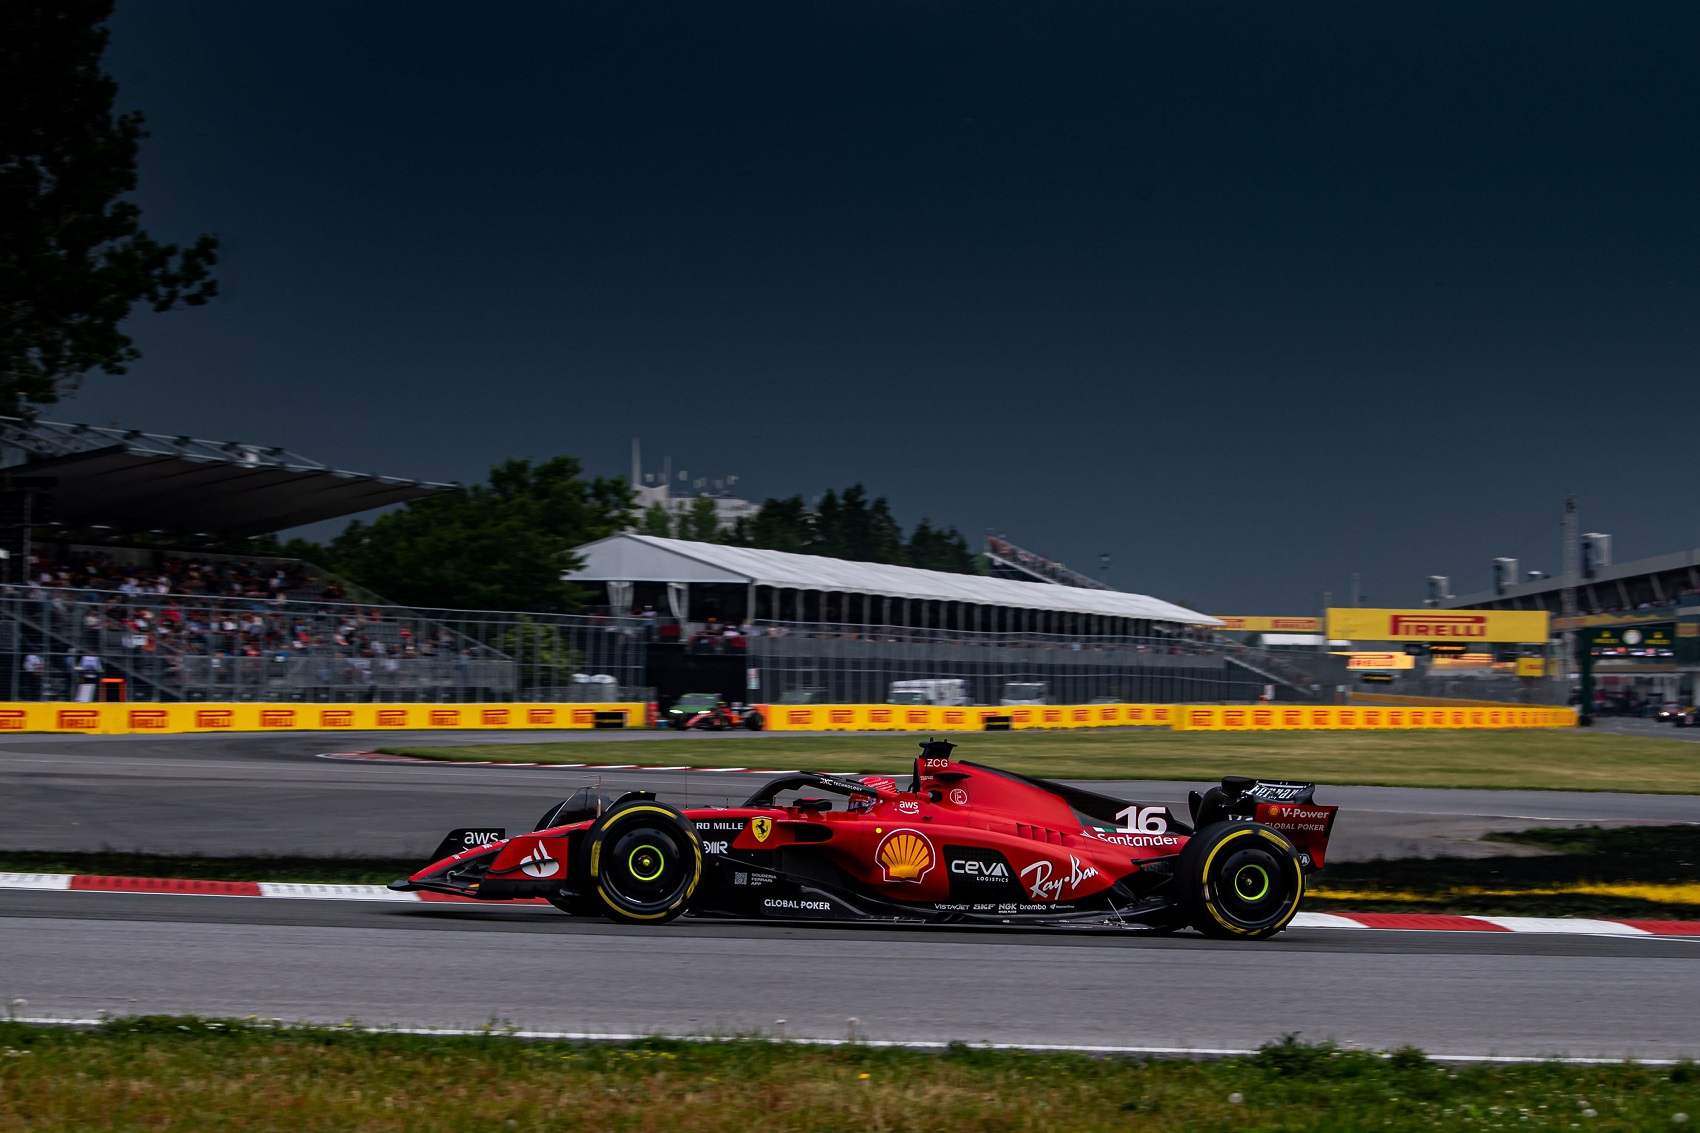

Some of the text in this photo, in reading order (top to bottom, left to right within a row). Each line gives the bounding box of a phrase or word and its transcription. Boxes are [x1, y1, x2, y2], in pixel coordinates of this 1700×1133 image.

[1390, 614, 1488, 637] PIRELLI
[57, 710, 99, 728] PIRELLI
[128, 710, 168, 728] PIRELLI
[195, 710, 234, 727] PIRELLI
[926, 758, 948, 768] ZCG
[833, 781, 863, 792] TECHNOLOGY
[899, 800, 919, 810] aws
[1115, 805, 1167, 835] 16
[1281, 807, 1329, 819] V-Power
[713, 822, 744, 830] MILLE
[1298, 823, 1325, 832] POKER
[464, 831, 499, 845] aws
[1097, 833, 1179, 847] Santander
[951, 859, 1009, 876] CEVA
[764, 898, 831, 911] GLOBAL POKER
